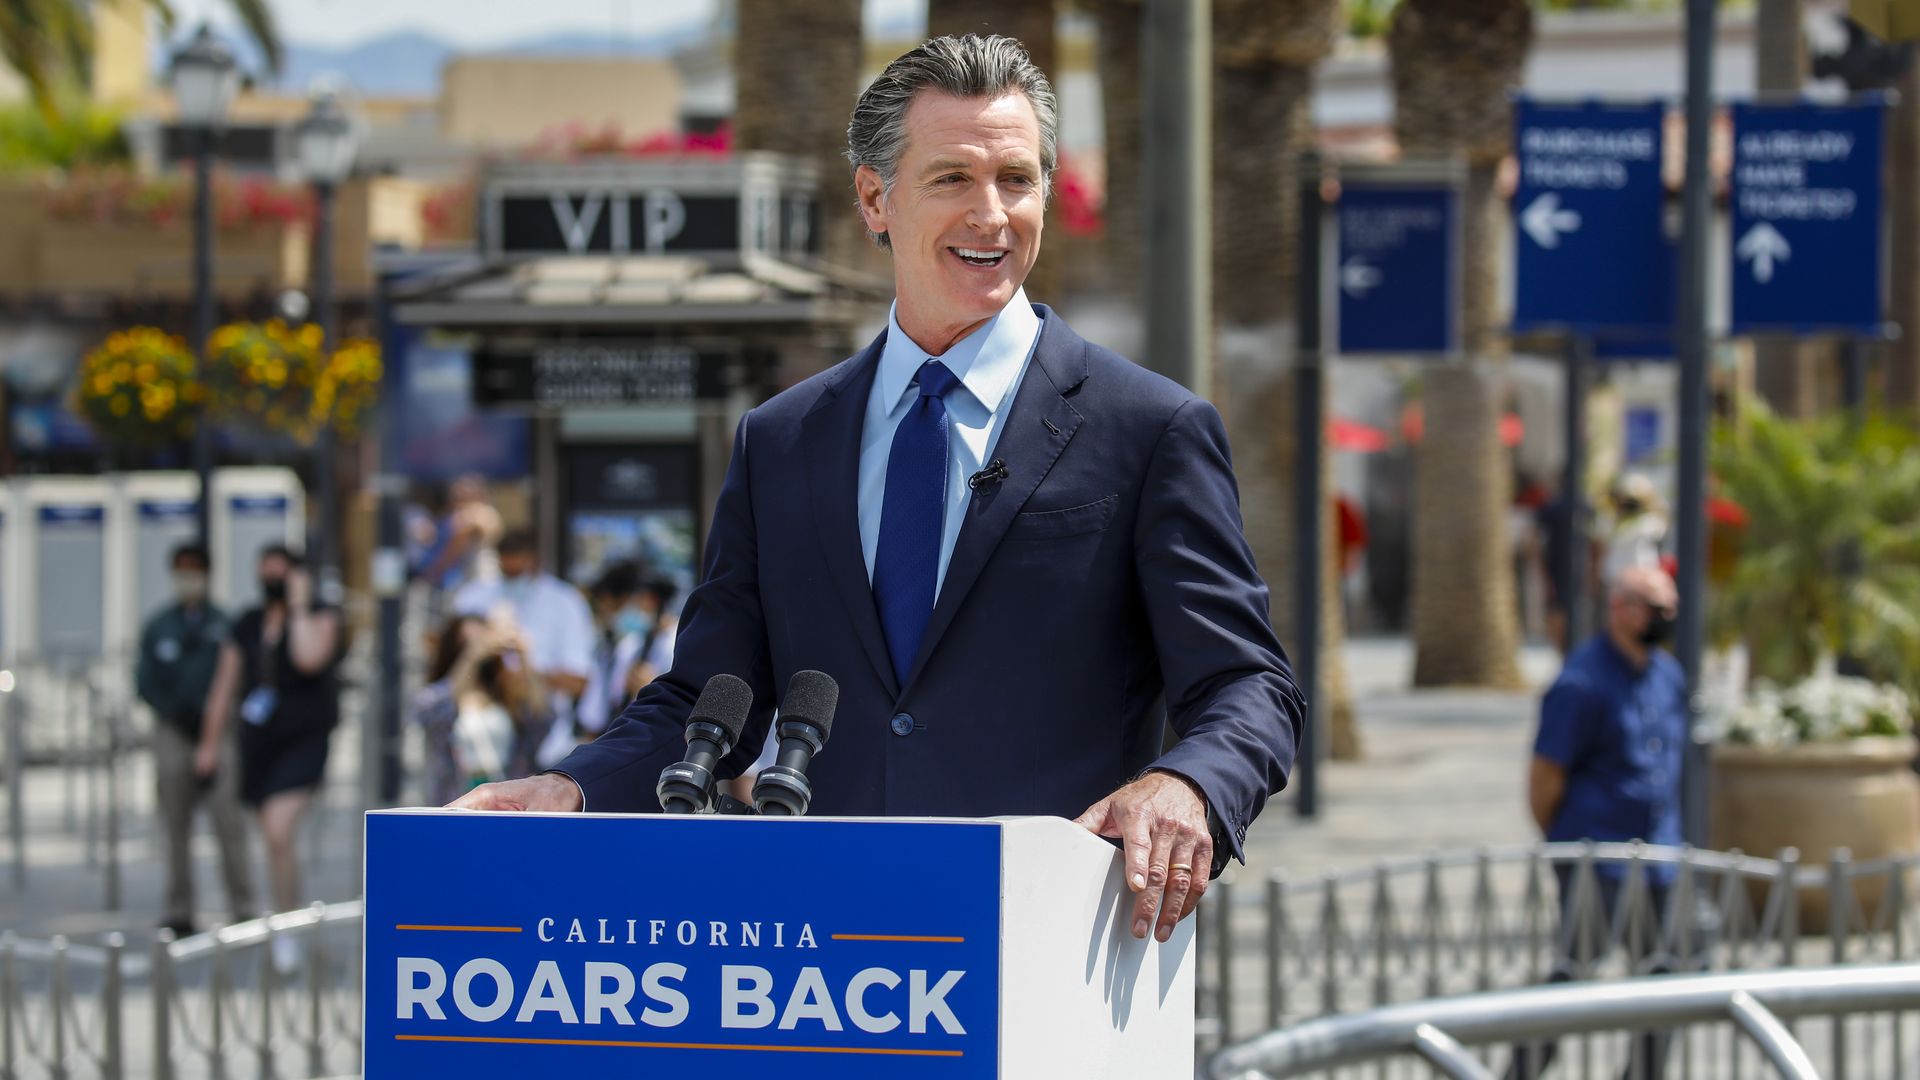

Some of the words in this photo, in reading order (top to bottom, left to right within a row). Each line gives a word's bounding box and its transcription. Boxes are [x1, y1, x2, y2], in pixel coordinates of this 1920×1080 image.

[1525, 157, 1628, 188] TICKETS
[1738, 162, 1806, 187] HAVE
[549, 188, 687, 256] VIP
[537, 917, 818, 948] CALIFORNIA
[396, 956, 690, 1028] ROARS
[721, 964, 967, 1035] BACK
